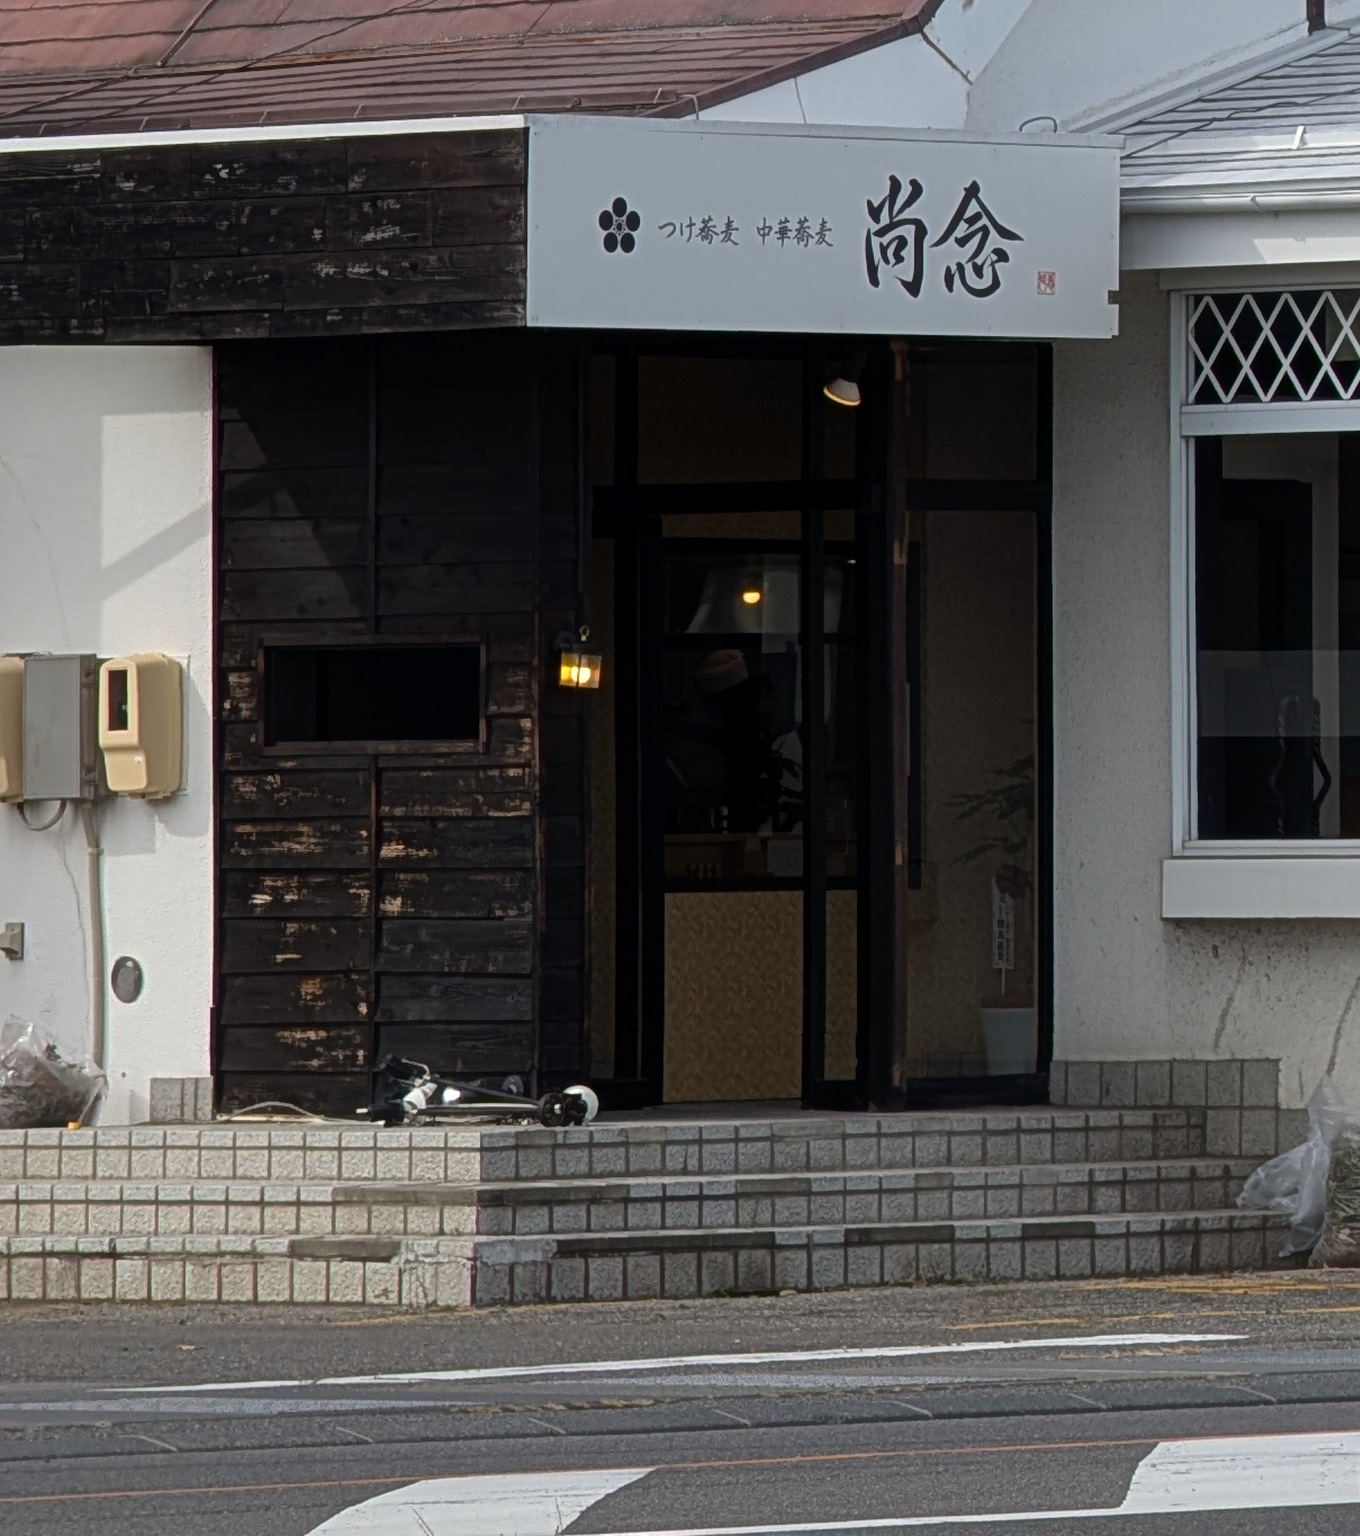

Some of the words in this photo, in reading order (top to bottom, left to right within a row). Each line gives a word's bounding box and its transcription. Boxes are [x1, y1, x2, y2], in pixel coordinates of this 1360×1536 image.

[658, 215, 739, 245] つけ蕎麦
[756, 216, 834, 248] 中華蕎麦
[865, 174, 1024, 298] 尚念
